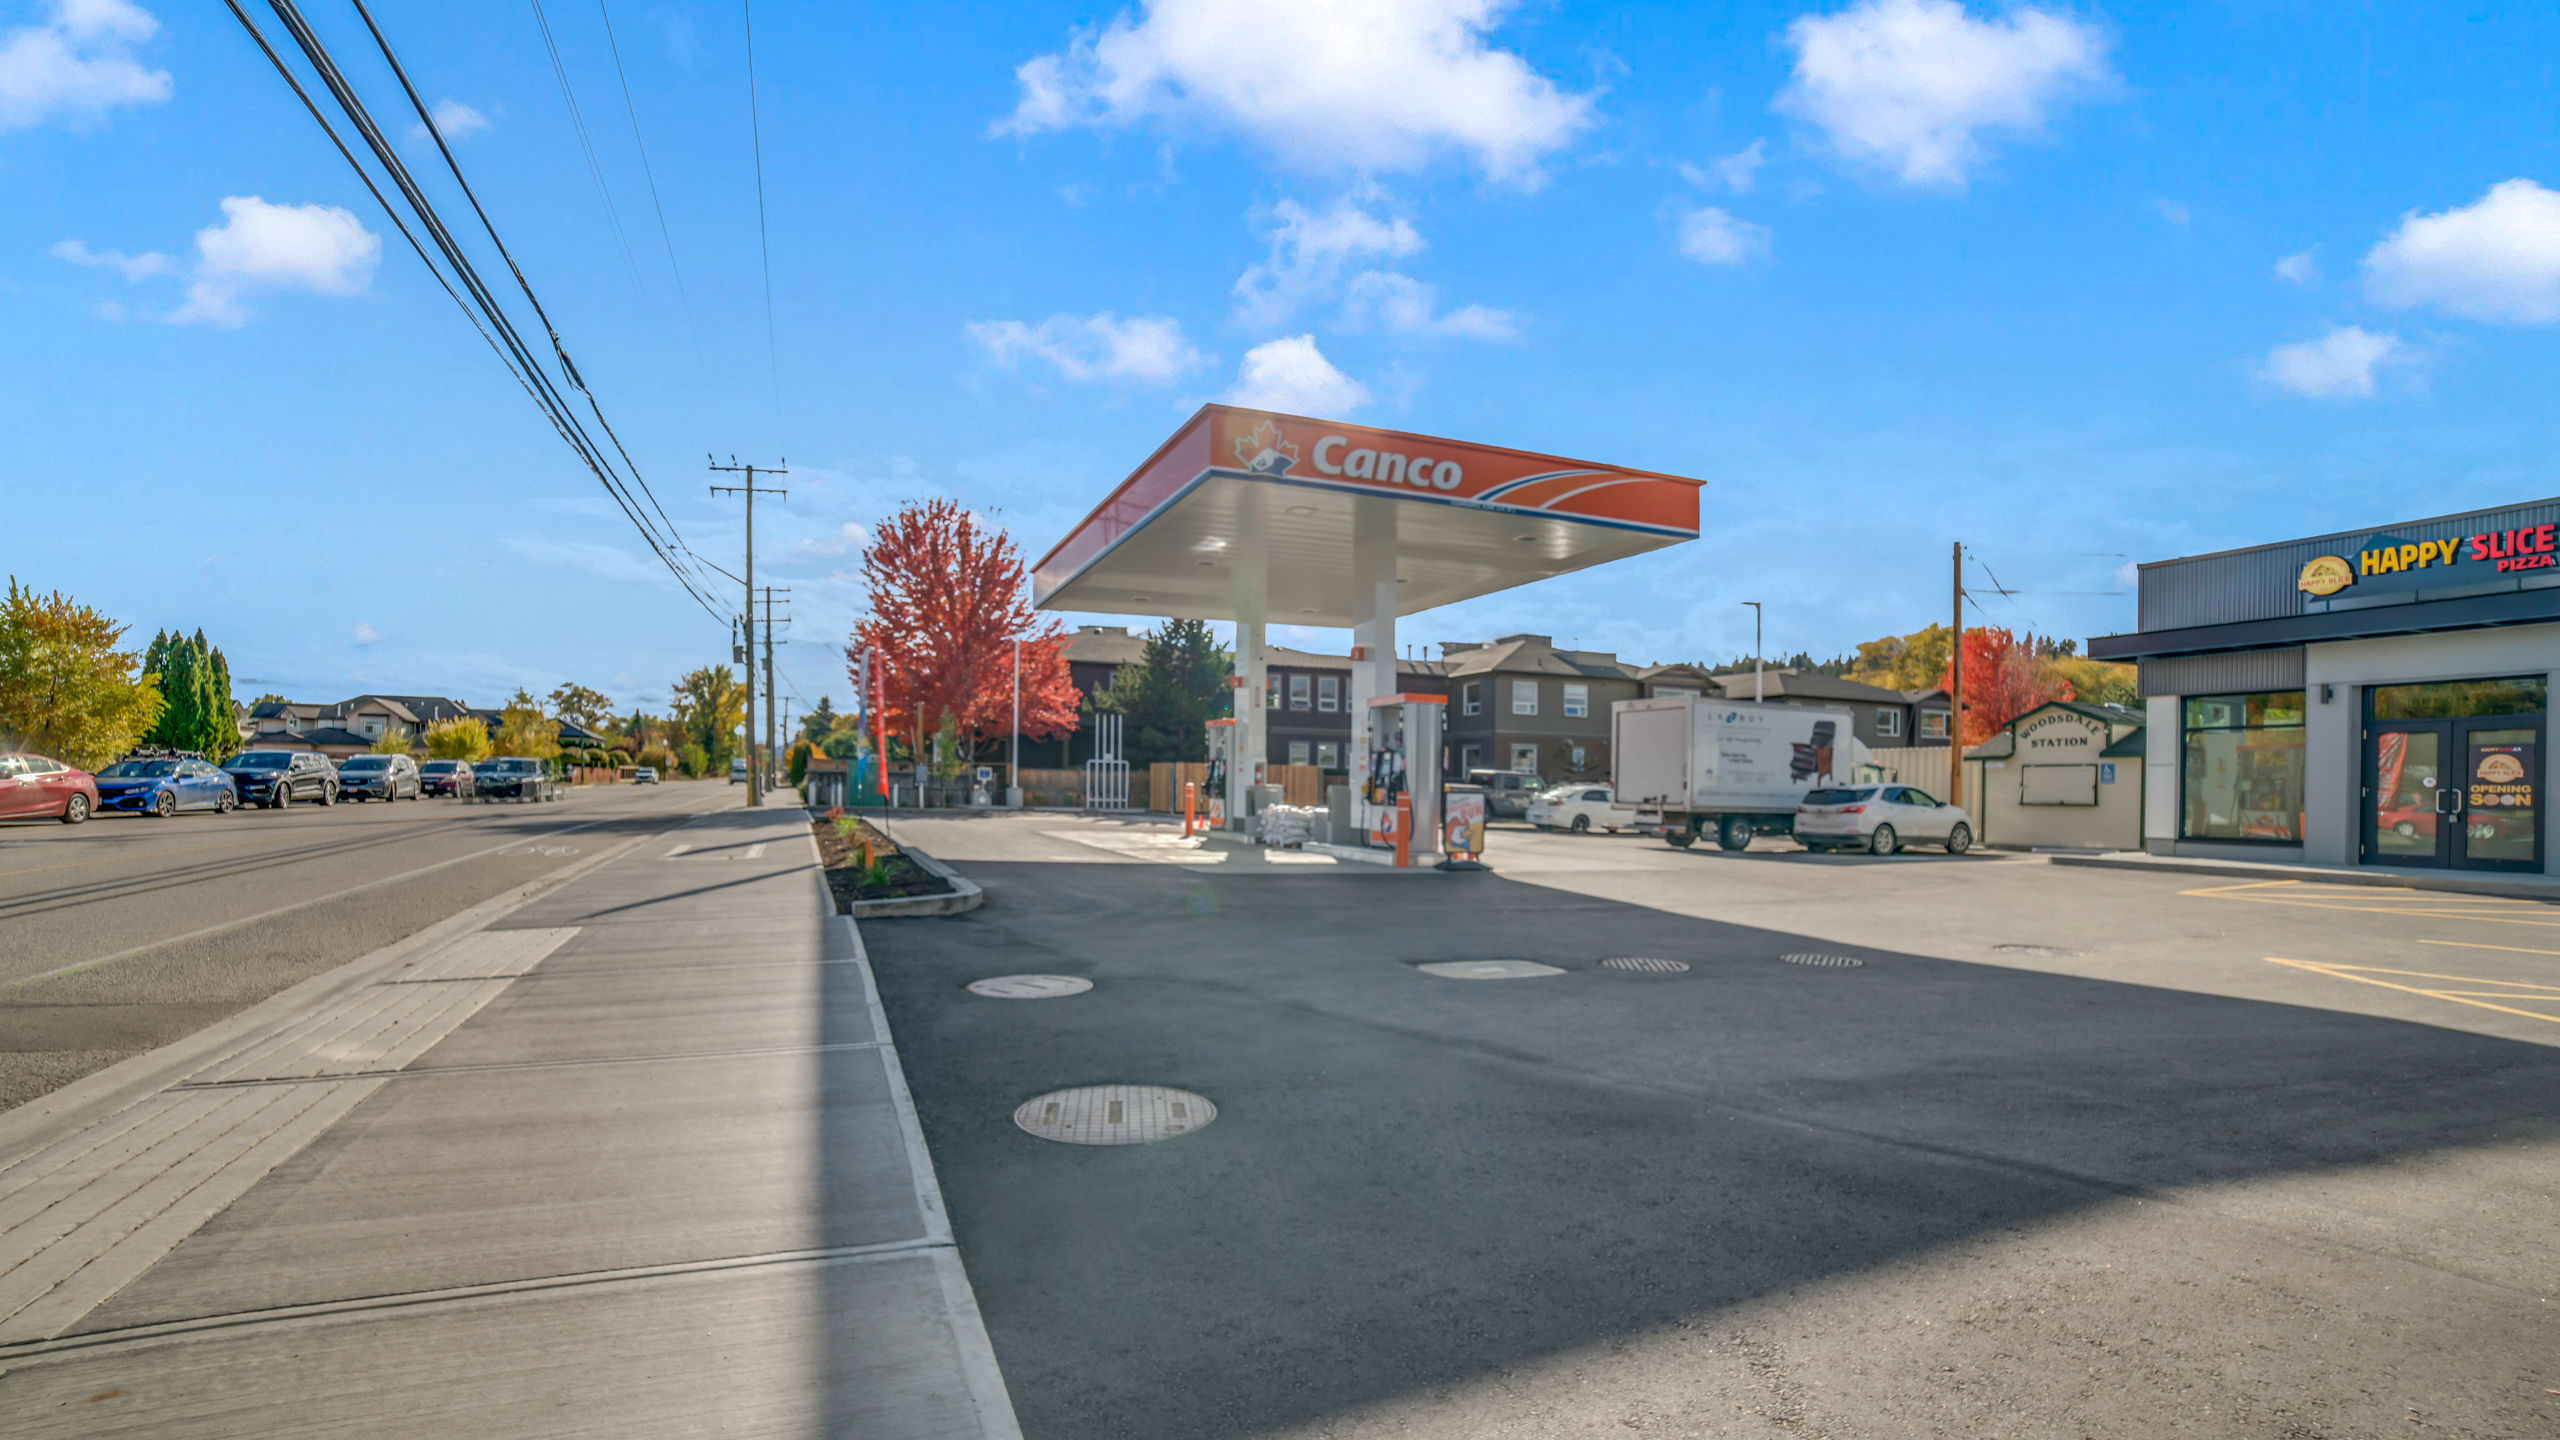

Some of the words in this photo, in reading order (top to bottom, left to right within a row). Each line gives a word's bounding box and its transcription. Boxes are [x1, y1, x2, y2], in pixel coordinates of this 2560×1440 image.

[1312, 435, 1463, 491] Canco
[2361, 537, 2461, 576] HAPPY
[2471, 523, 2555, 561] SLICE
[2497, 554, 2555, 573] PIZZA
[2300, 578, 2326, 588] HAPPY
[2328, 576, 2350, 585] SLICE
[2020, 713, 2101, 740] WOODSDALE
[2031, 737, 2088, 748] STATION
[2470, 784, 2532, 793] OPENING
[2469, 793, 2532, 806] SOON
